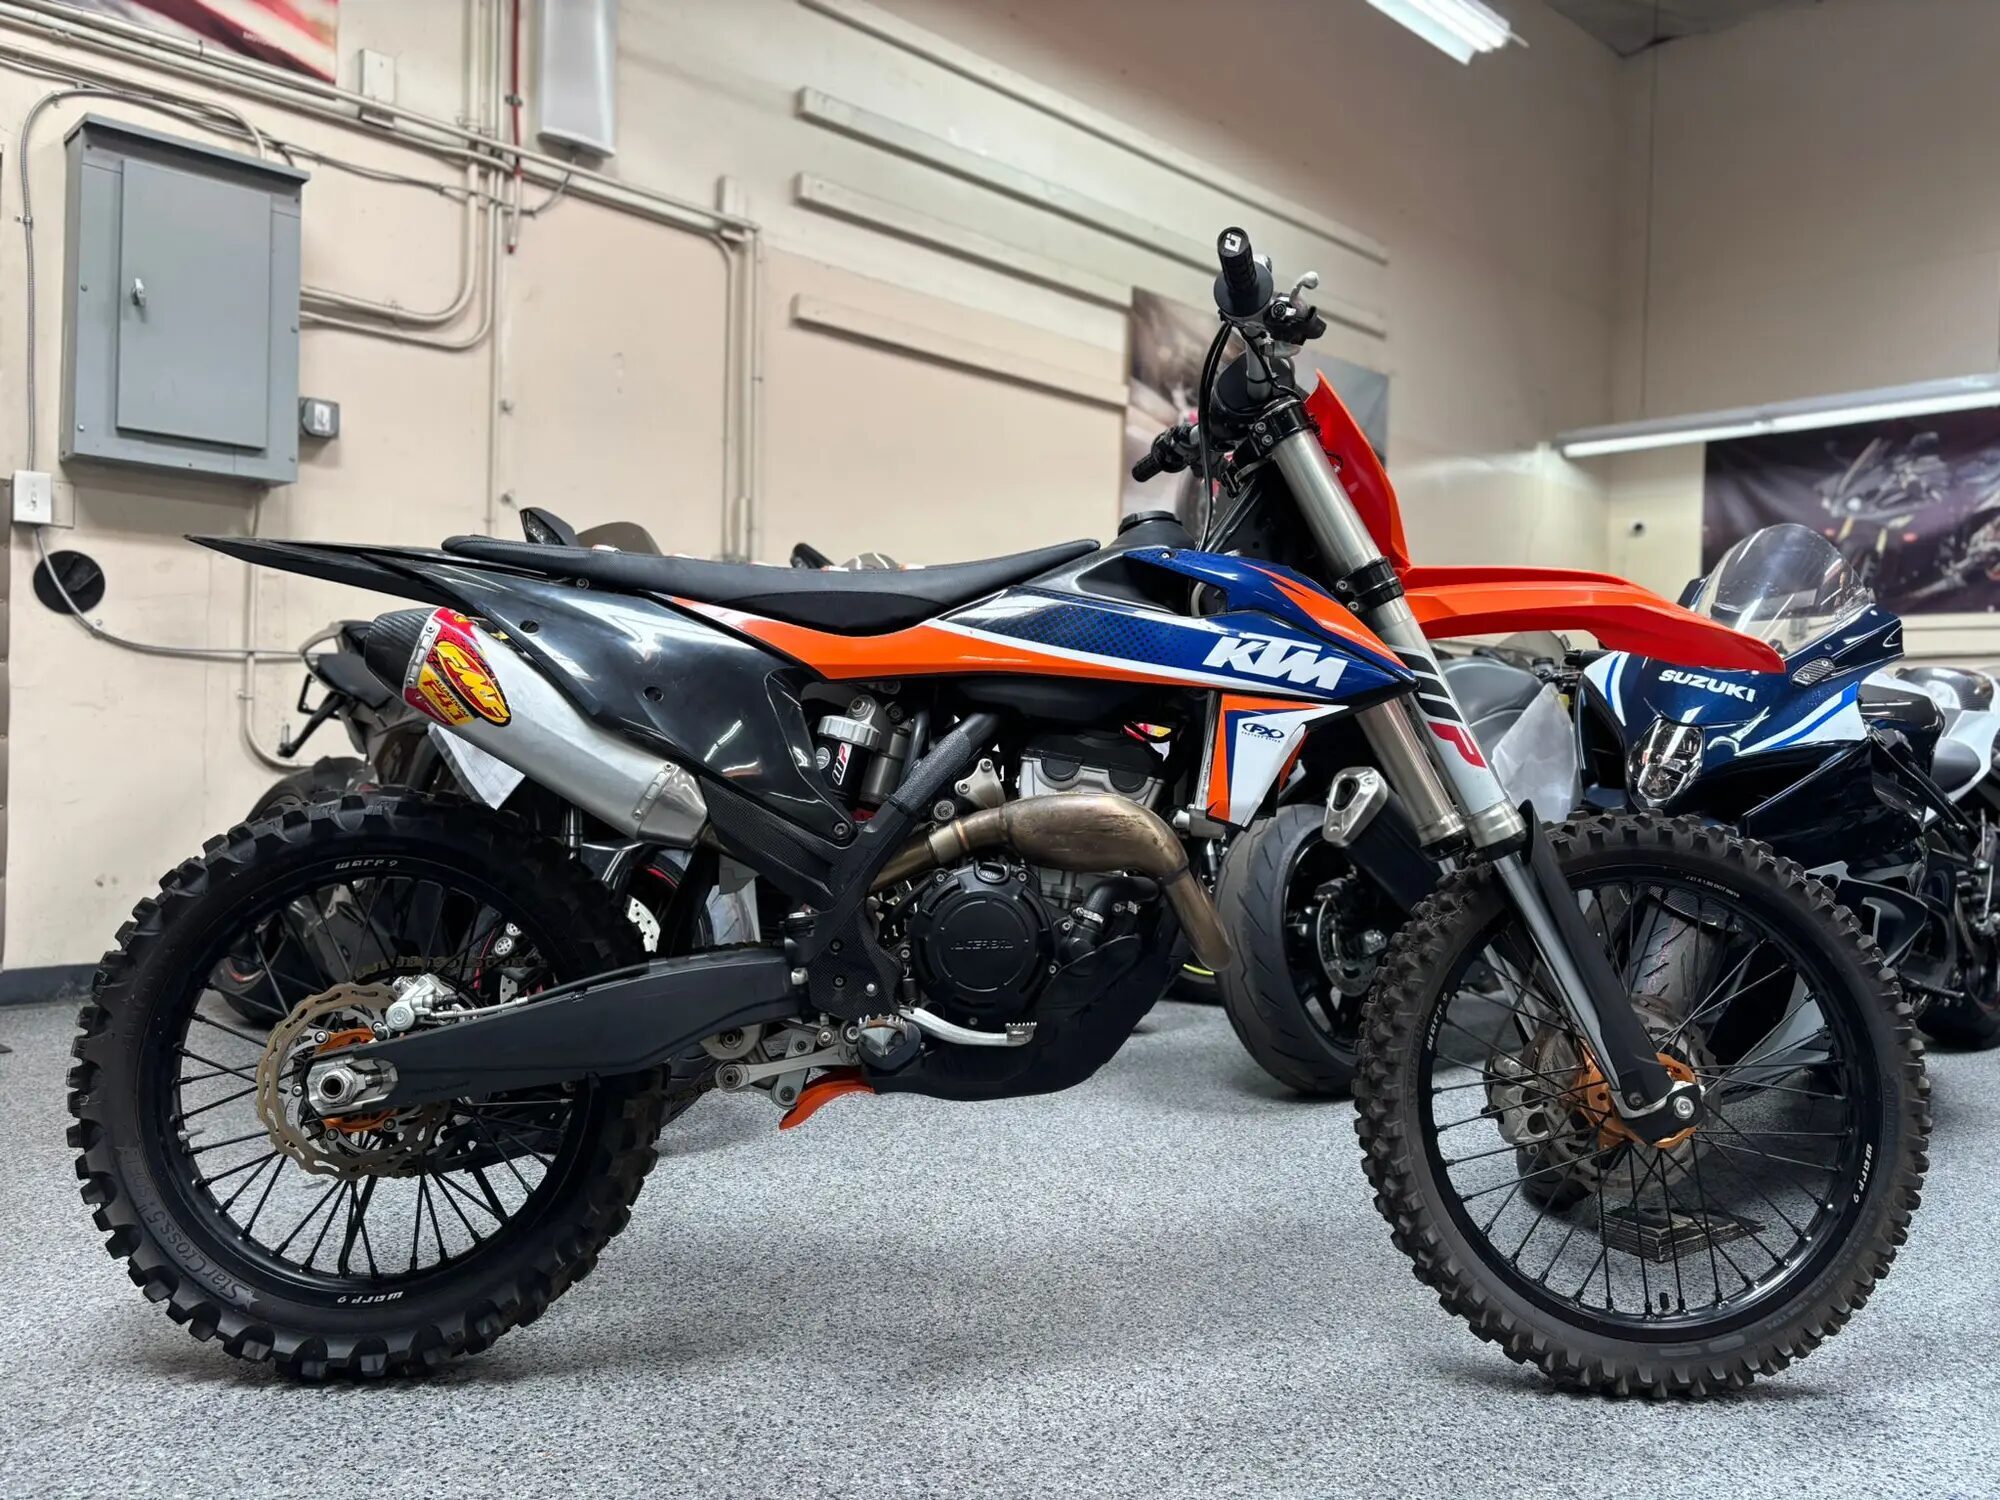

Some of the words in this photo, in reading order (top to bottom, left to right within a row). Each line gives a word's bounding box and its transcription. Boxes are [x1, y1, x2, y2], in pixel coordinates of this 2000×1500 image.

[1202, 631, 1349, 691] KTM
[434, 644, 511, 719] FMF
[1658, 669, 1757, 703] SUZUKI
[422, 680, 468, 720] F4.1
[1853, 1193, 1860, 1204] 9
[146, 1209, 165, 1224] 5
[337, 1295, 347, 1303] 9
